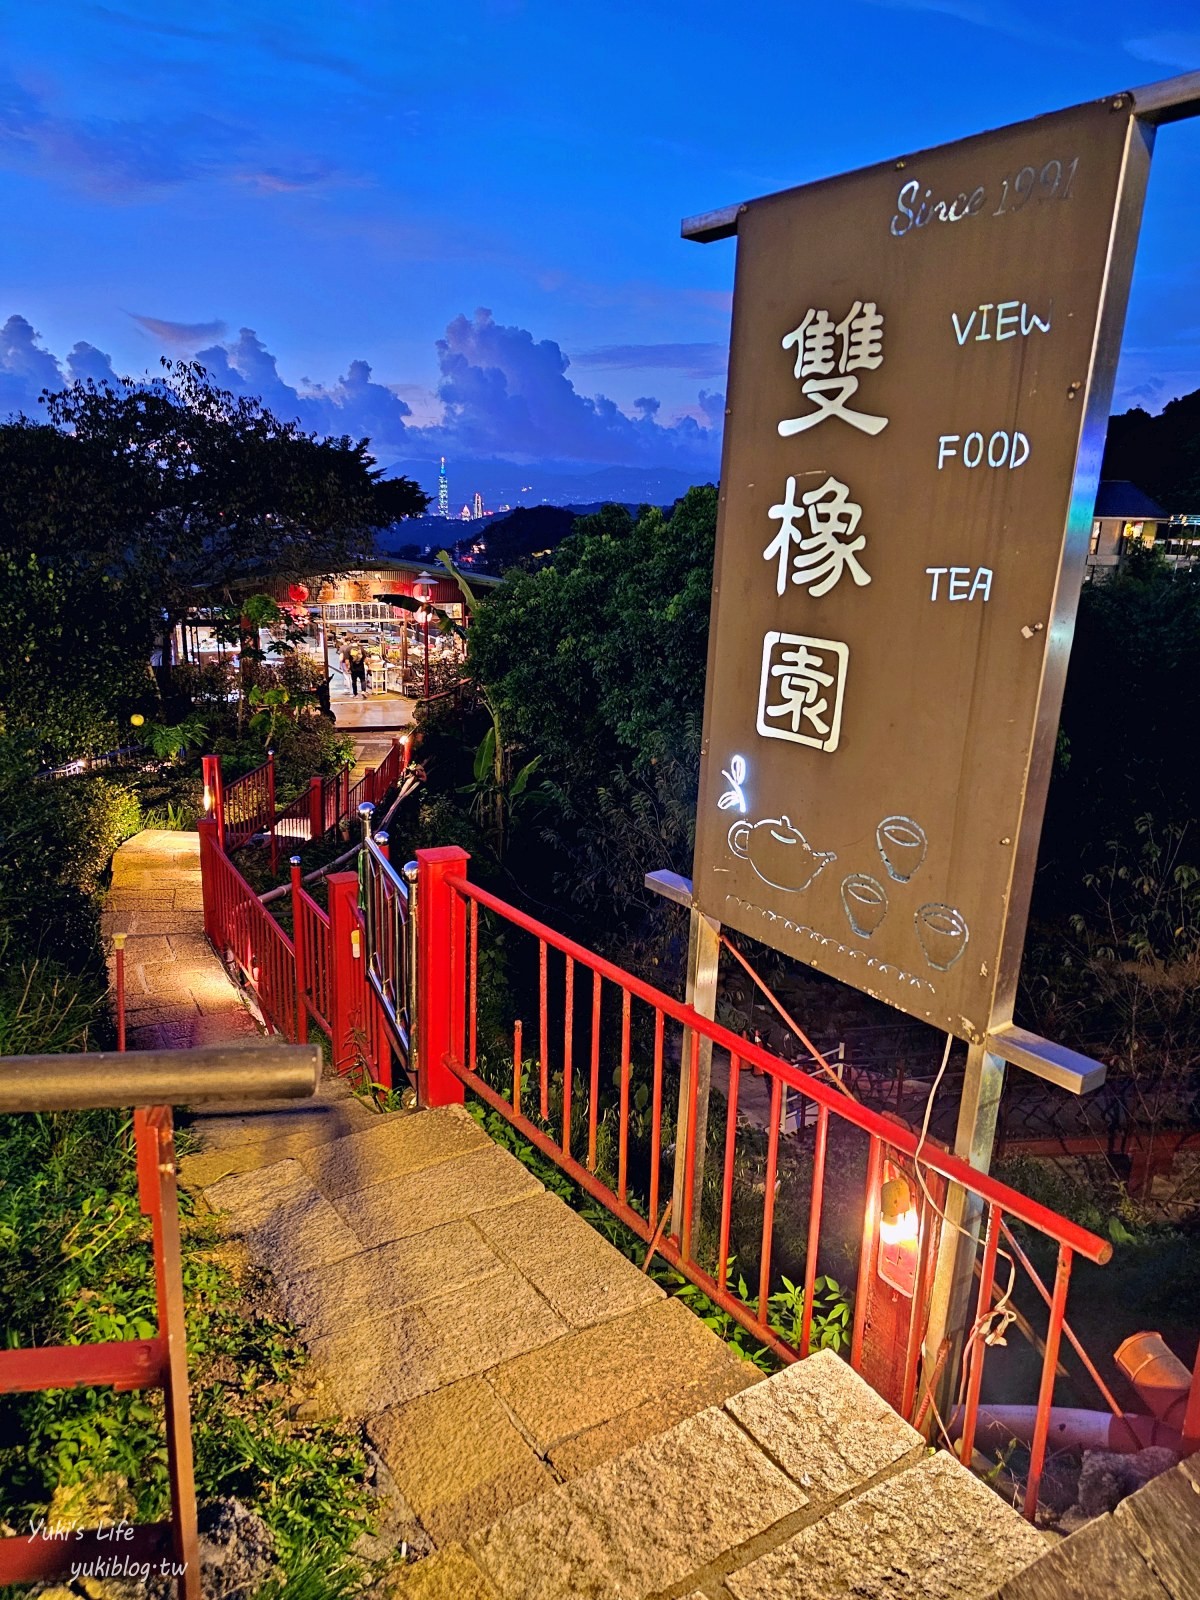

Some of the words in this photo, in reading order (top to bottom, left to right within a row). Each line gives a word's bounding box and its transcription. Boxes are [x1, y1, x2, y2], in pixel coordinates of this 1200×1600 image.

[889, 179, 986, 236] Since
[992, 156, 1080, 217] 1991
[951, 299, 1052, 345] VIEW
[938, 431, 1030, 470] FOOD
[756, 300, 889, 753] 雙橡園
[925, 566, 993, 602] TEA
